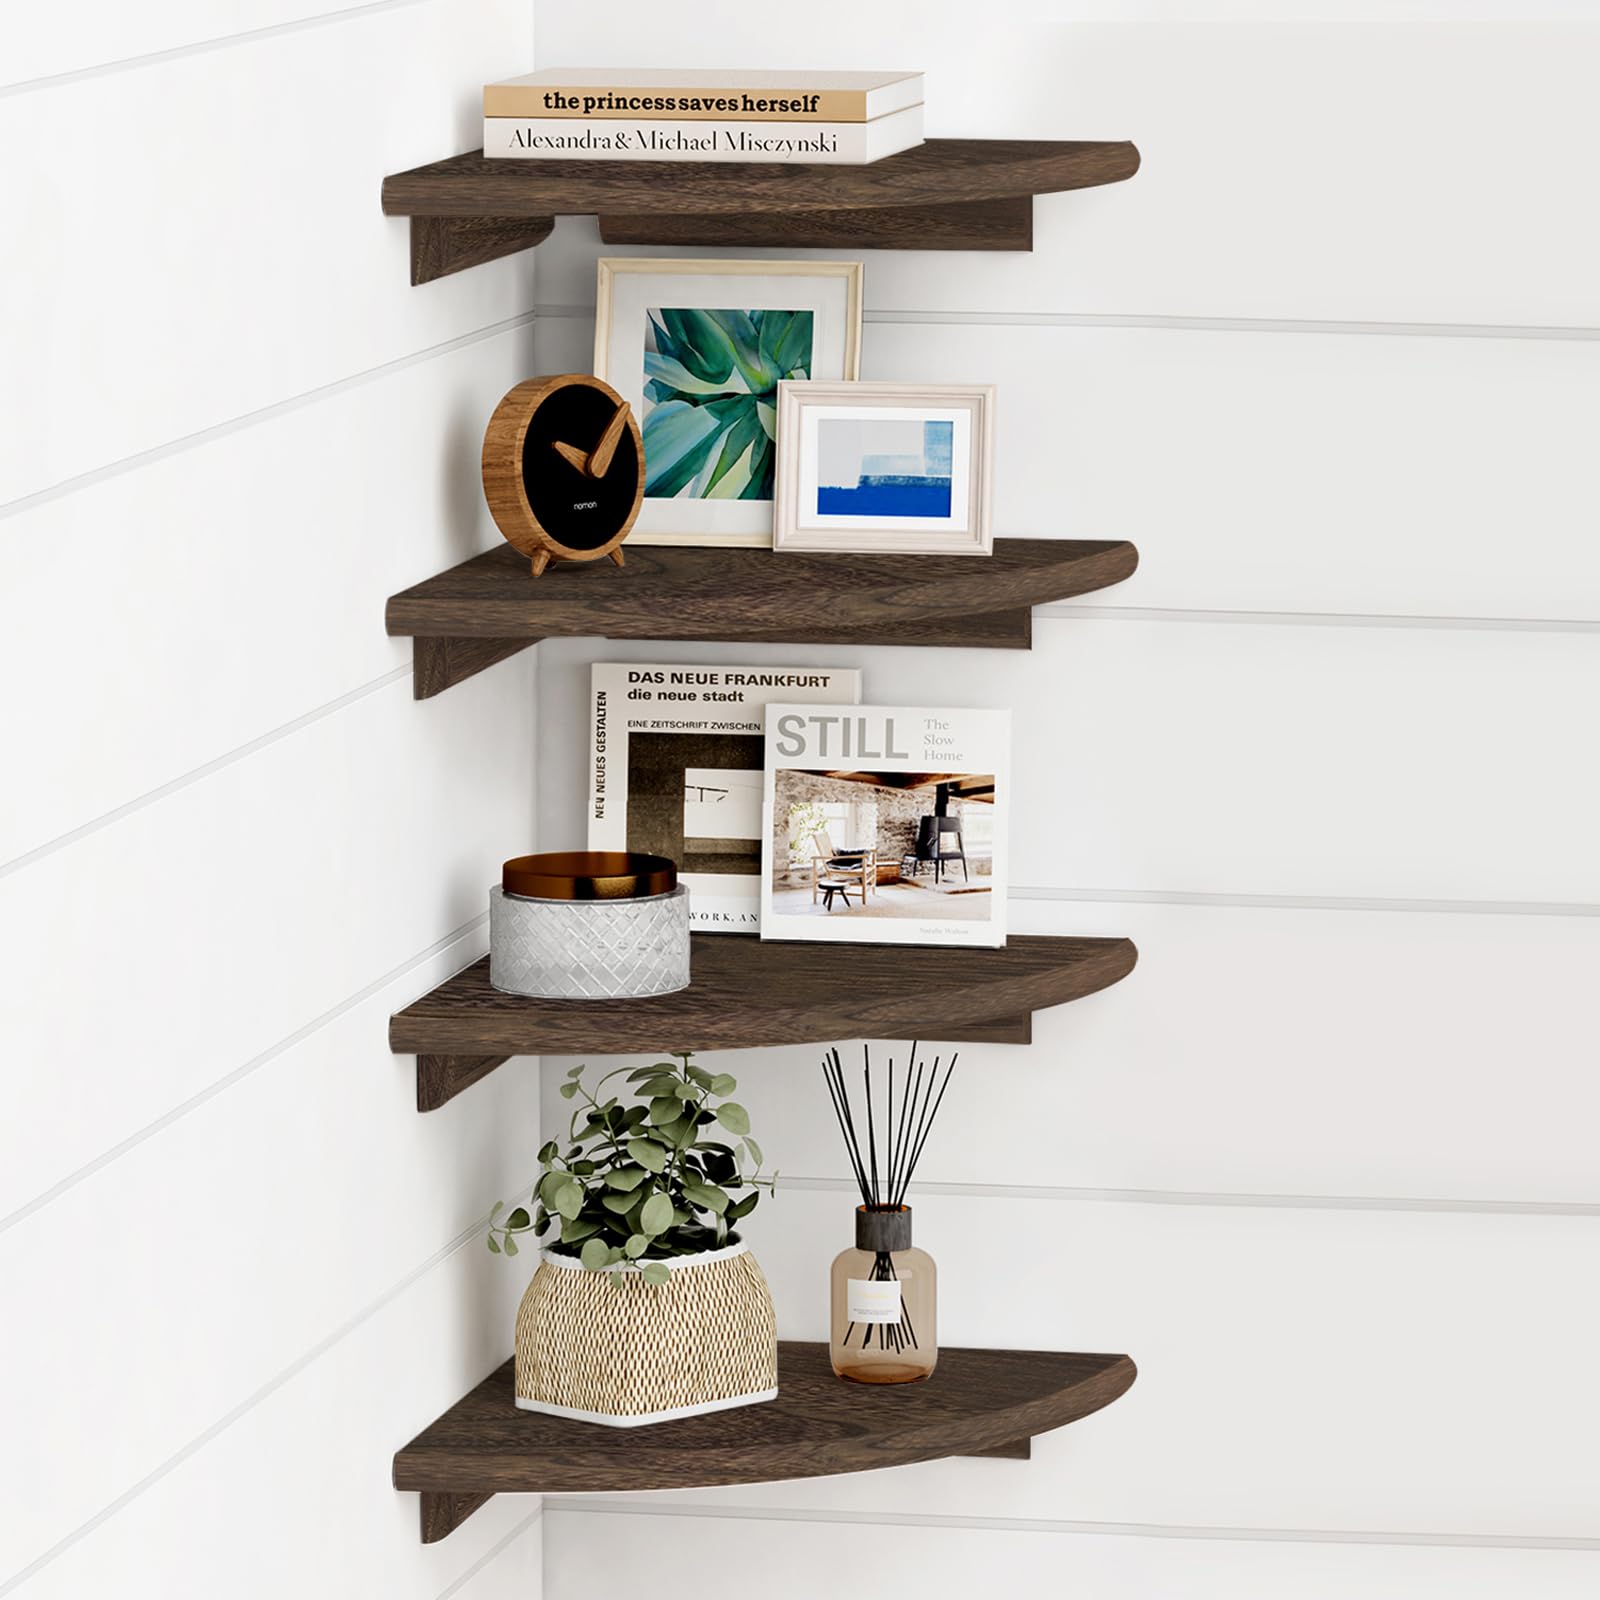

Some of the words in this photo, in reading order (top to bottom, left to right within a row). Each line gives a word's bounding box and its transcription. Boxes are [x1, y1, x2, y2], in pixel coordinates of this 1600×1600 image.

[543, 91, 580, 110] the
[582, 92, 677, 114] princess
[679, 97, 739, 112] saves
[741, 93, 821, 113] herself
[508, 127, 611, 150] Alexandra
[614, 131, 632, 150] &
[635, 129, 717, 151] Michael
[724, 131, 837, 158] Misczynski
[573, 501, 598, 510] nomon
[628, 671, 665, 684] DAS
[670, 672, 719, 685] NEUE
[724, 673, 831, 688] FRANKFURT
[627, 688, 652, 701] die
[657, 690, 697, 702] neue
[702, 690, 744, 703] stadt
[596, 691, 607, 753] GESTALTEN
[627, 719, 649, 729] EINE
[650, 720, 709, 730] ZEITSCHRIFT
[710, 721, 761, 731] ZWISCHEN
[923, 718, 951, 731] The
[775, 714, 909, 759] STILL
[923, 733, 955, 746] Slow
[924, 749, 965, 761] Home
[595, 755, 607, 793] NEUES
